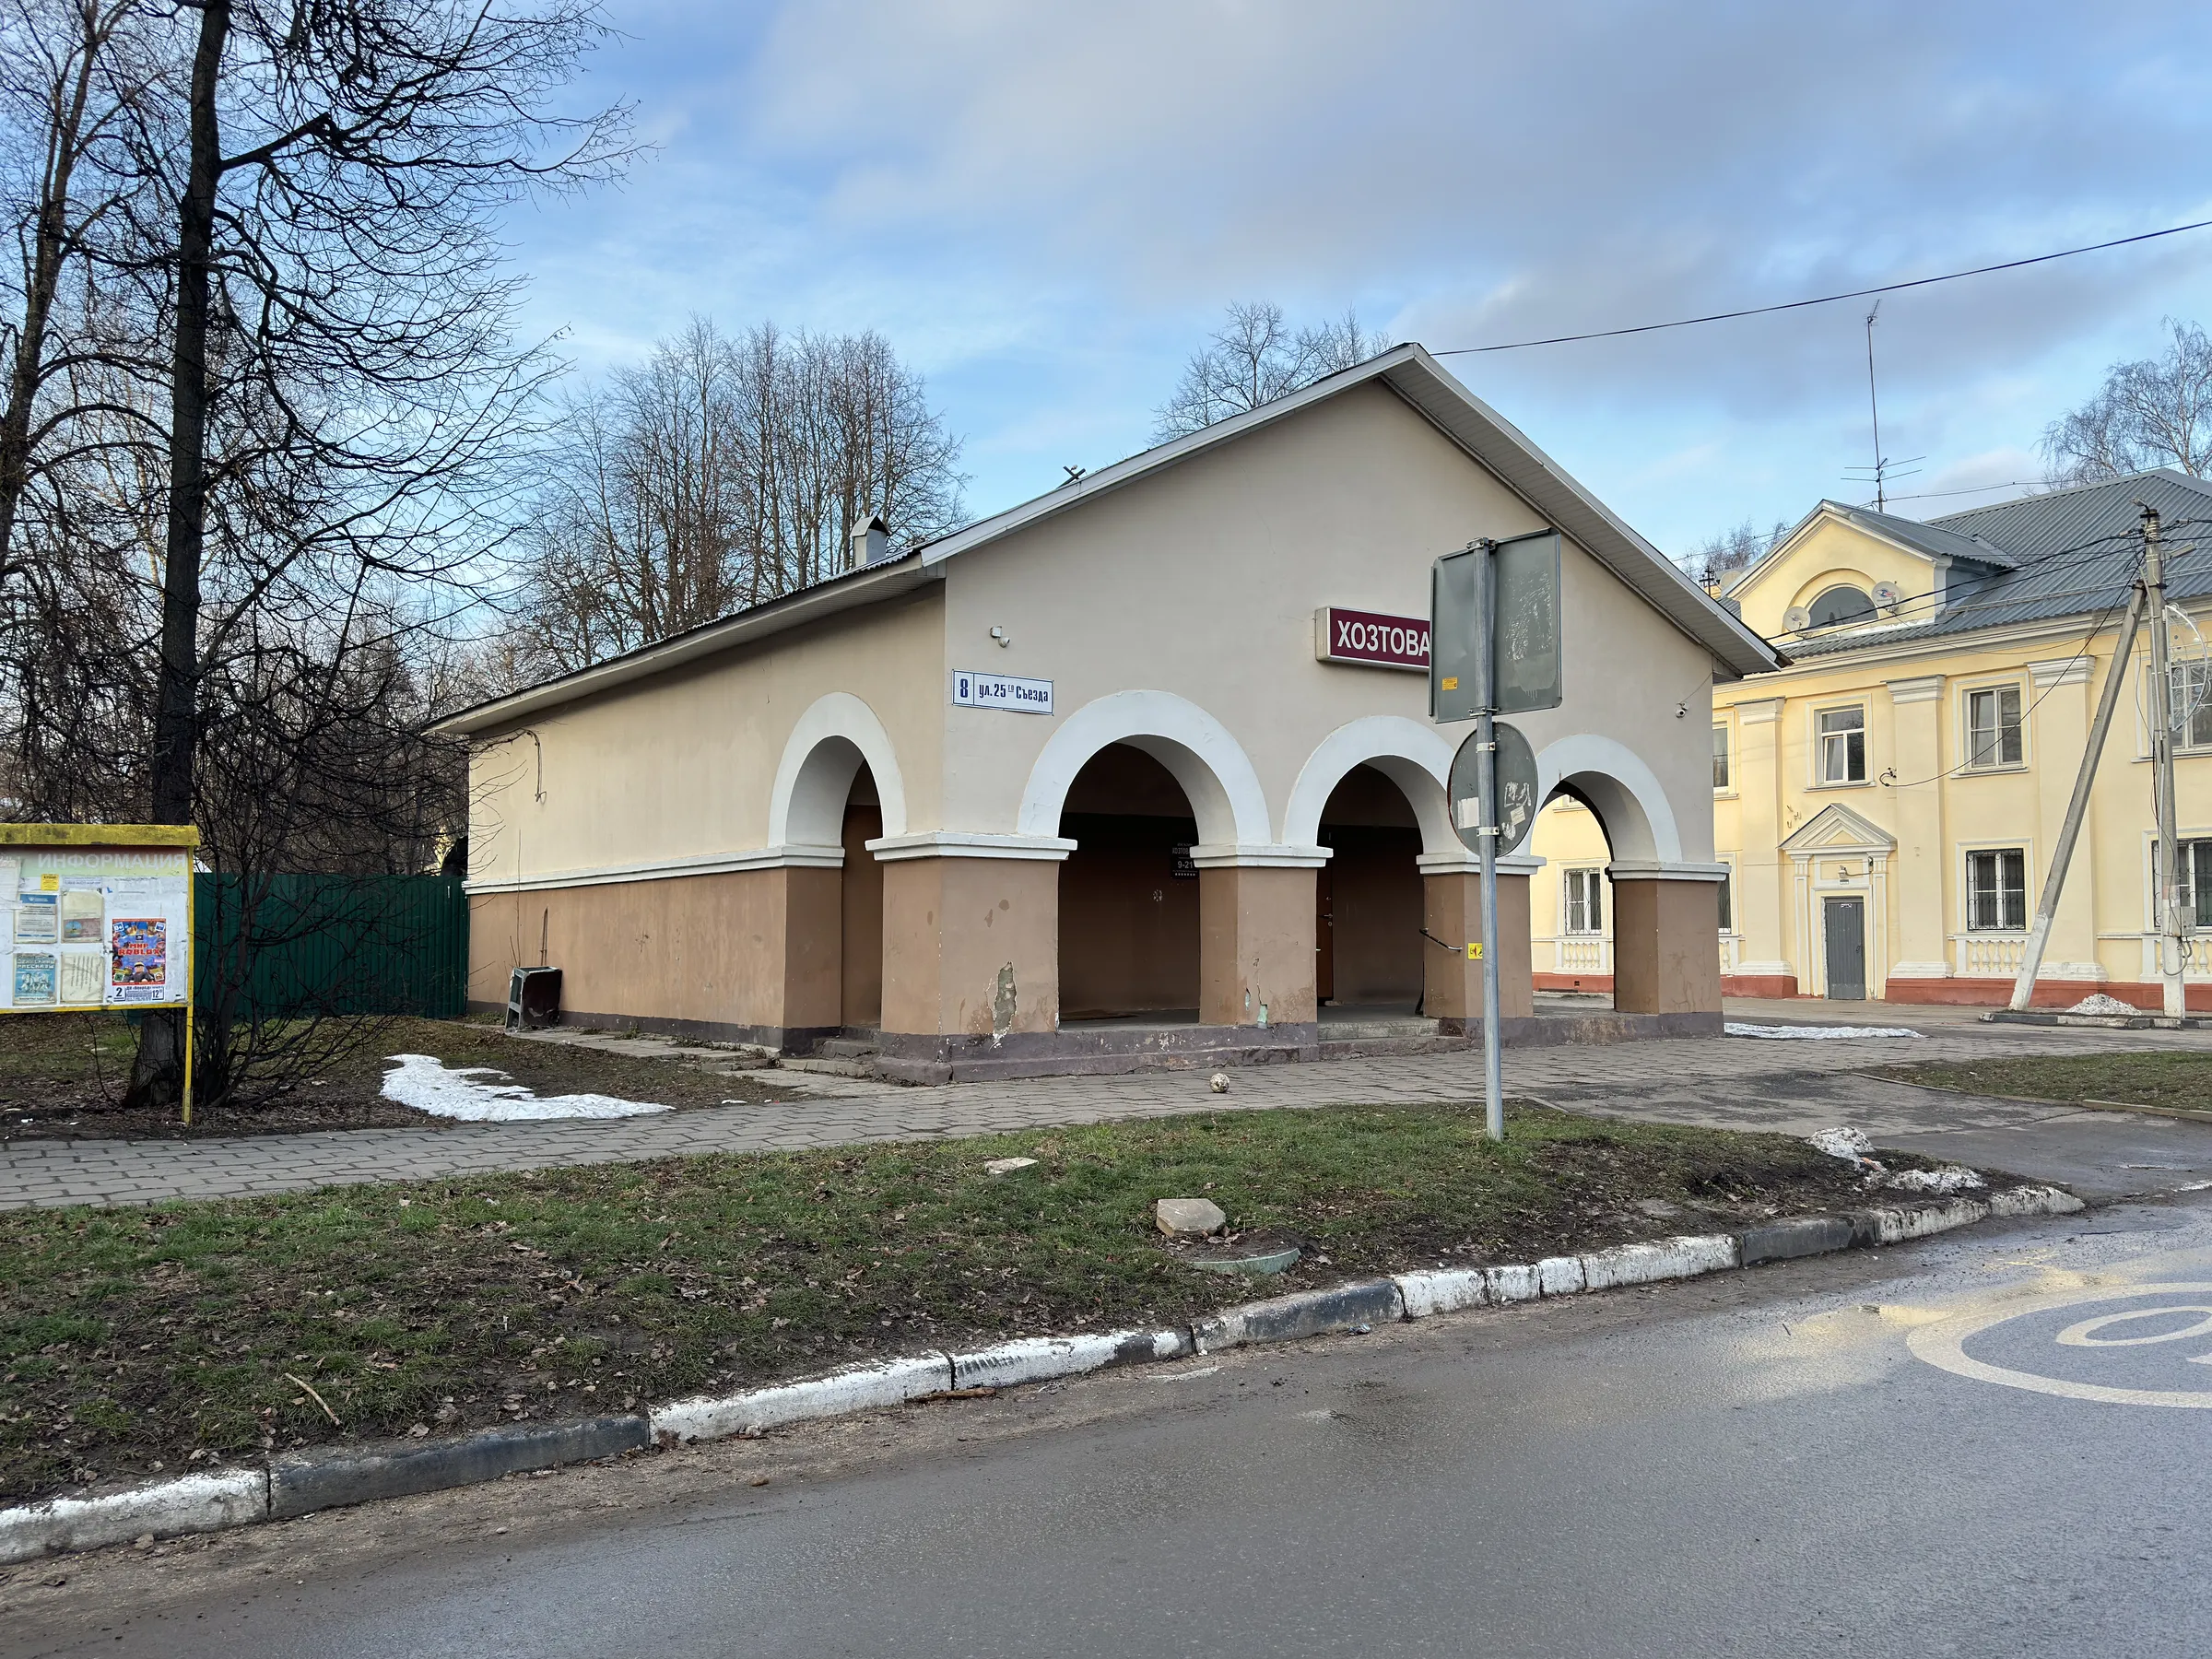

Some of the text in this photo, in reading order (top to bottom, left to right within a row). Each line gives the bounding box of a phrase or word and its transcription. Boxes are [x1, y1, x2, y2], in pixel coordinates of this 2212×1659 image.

[1337, 620, 1430, 656] ХОЗТОВА
[959, 678, 969, 698] 8
[979, 684, 993, 698] ул.
[1016, 686, 1049, 702] Съезда
[38, 853, 185, 870] ИНФОРМАЦИЯ
[1177, 860, 1194, 869] 9-21
[116, 987, 123, 996] 2
